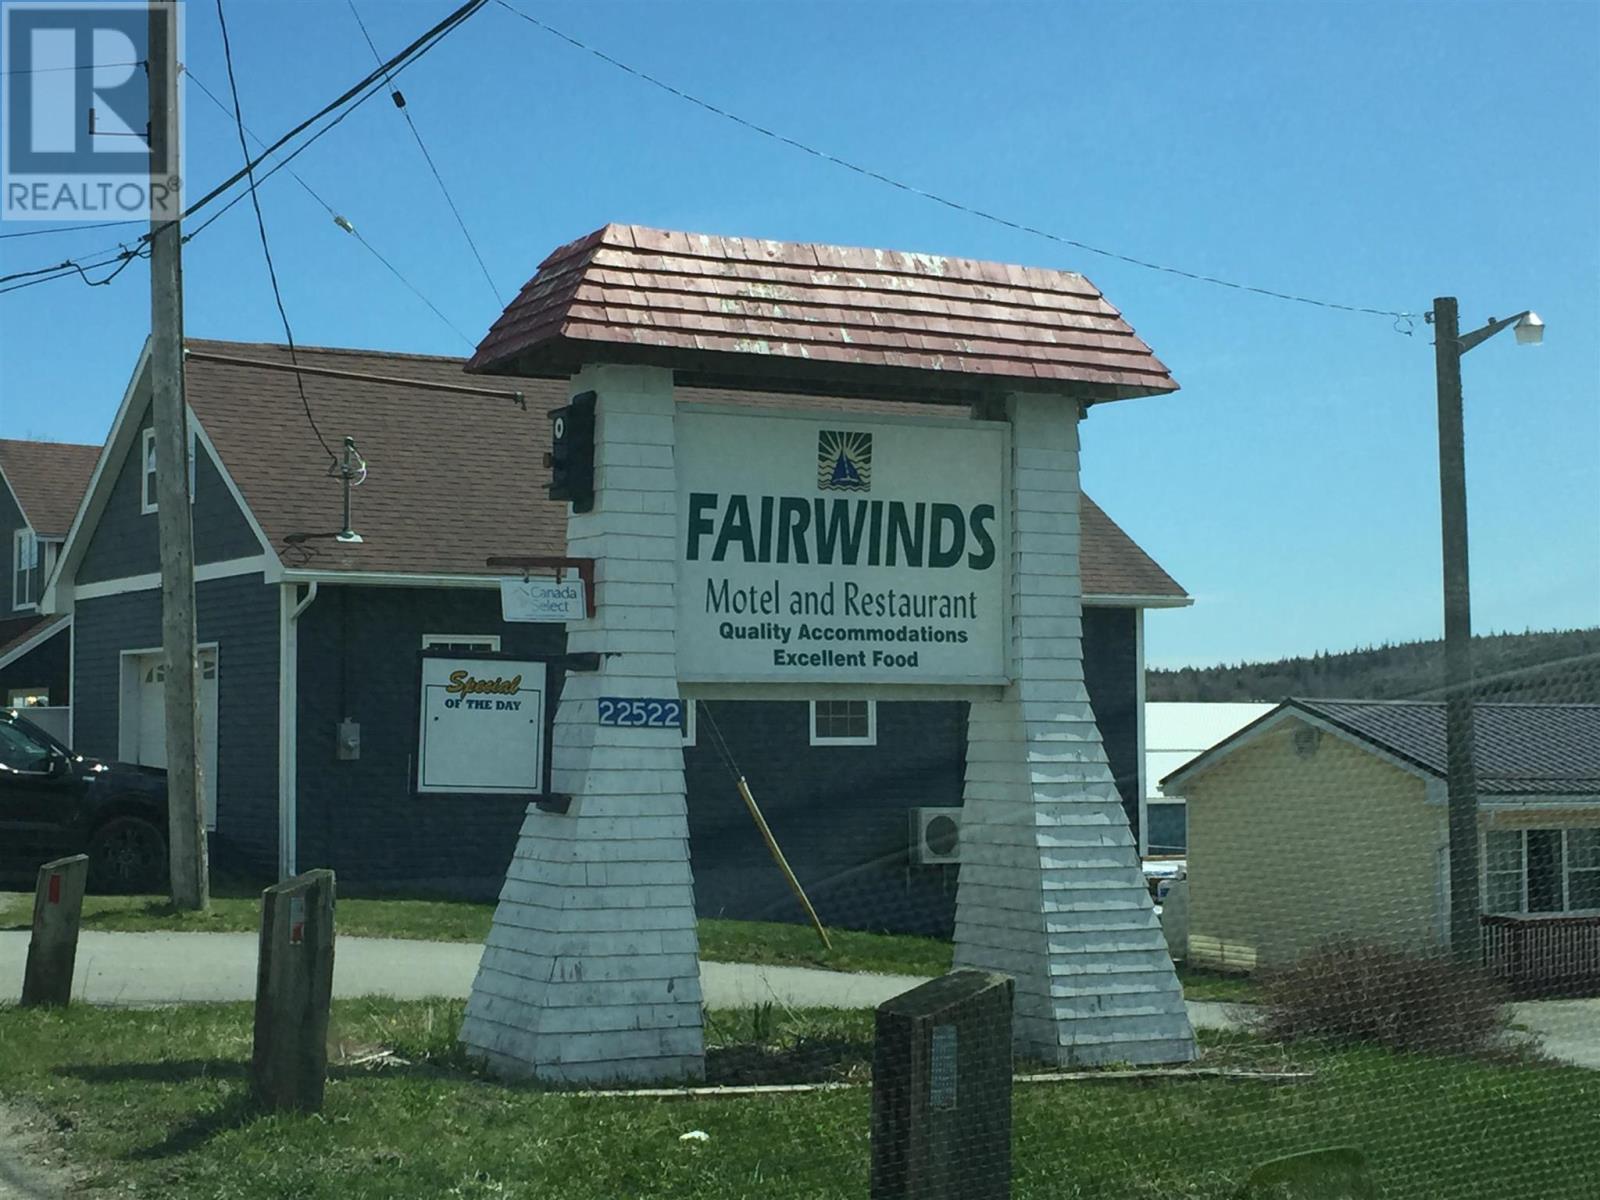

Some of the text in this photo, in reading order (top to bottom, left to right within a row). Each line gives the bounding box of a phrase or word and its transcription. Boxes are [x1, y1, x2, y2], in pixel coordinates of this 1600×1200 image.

[686, 492, 996, 570] FAIRWINDS
[530, 586, 577, 600] Canada
[705, 577, 978, 619] Motel and Restaurant
[719, 622, 969, 643] Quality Accommodations
[773, 649, 919, 668] Excellent Food
[445, 670, 522, 699] Special
[445, 699, 522, 711] OF THE DAY
[599, 702, 681, 726] 22522
